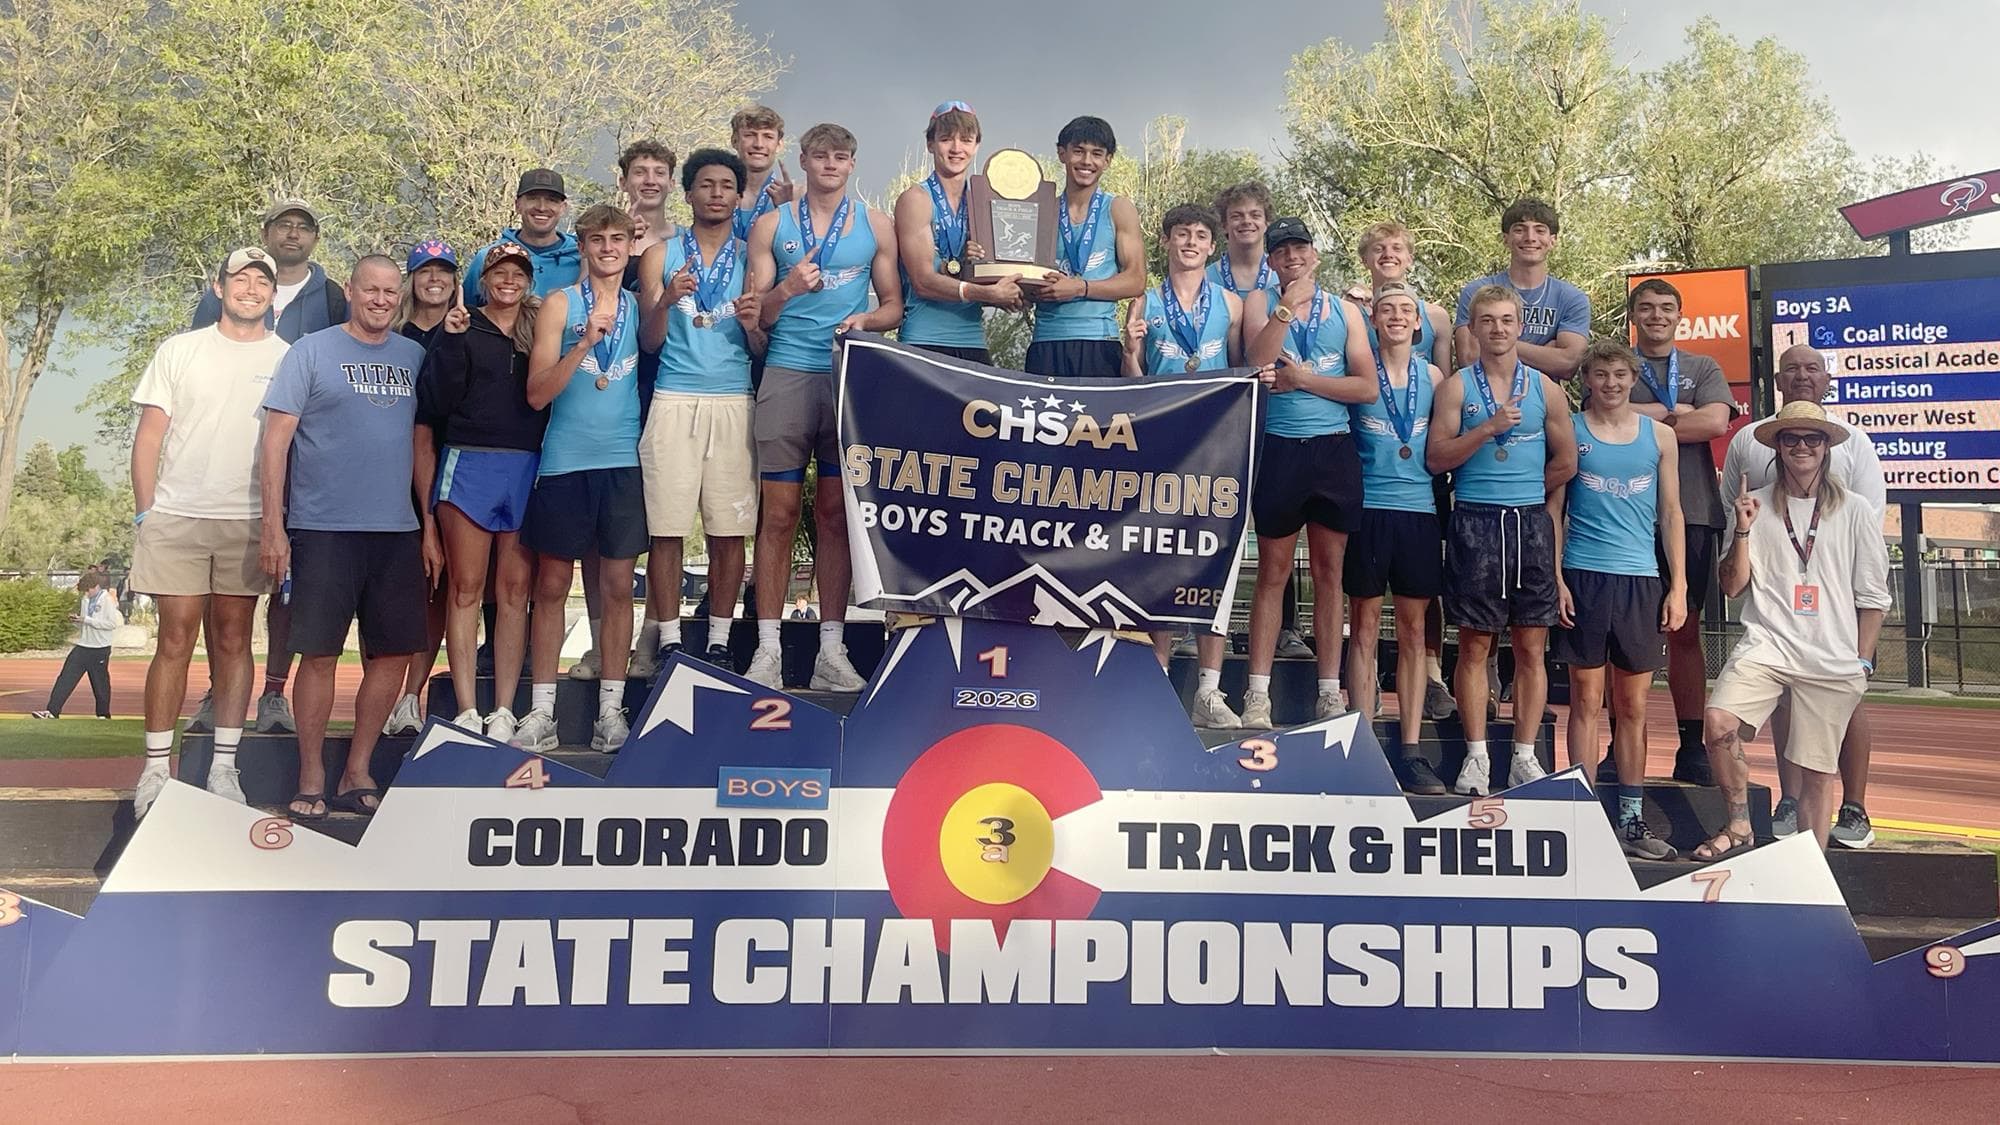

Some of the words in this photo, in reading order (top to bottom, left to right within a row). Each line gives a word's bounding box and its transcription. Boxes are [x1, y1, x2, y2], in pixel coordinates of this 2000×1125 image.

[1521, 306, 1557, 327] TAN
[1776, 299, 1821, 319] Boys
[1826, 296, 1851, 314] 3A
[1675, 314, 1741, 341] BANK
[1786, 329, 1795, 345] 1
[1843, 324, 1886, 343] Coal
[1892, 322, 1948, 343] Ridge
[1844, 353, 1929, 371] Classical
[1936, 349, 2000, 367] Acade
[341, 363, 414, 388] TITAN
[1845, 381, 1933, 399] Harrison
[353, 384, 378, 394] TRACK
[390, 386, 411, 397] FIELD
[961, 400, 1139, 451] CHSAA
[1847, 411, 1918, 427] Denver
[1924, 409, 1976, 425] West
[1873, 437, 1946, 459] asburg
[846, 444, 979, 500] STATE
[992, 461, 1240, 519] CHAMPIONS
[1884, 467, 1979, 484] urrection
[859, 501, 948, 536] BOYS
[960, 512, 1075, 548] TRACK
[1085, 523, 1109, 551] &
[1122, 525, 1219, 557] FIELD
[976, 645, 1009, 678] 1
[956, 690, 1037, 708] 2026
[750, 698, 793, 731] 2
[1238, 738, 1278, 772] 3
[505, 757, 550, 790] 4
[726, 777, 823, 799] BOYS
[1468, 796, 1508, 829] 5
[249, 818, 294, 850] 6
[468, 817, 829, 868] COLORADO
[1118, 822, 1336, 874] TRACK
[1349, 826, 1392, 874] &
[1404, 828, 1567, 877] FIELD
[1691, 870, 1731, 903] 7
[328, 919, 693, 1008] STATE
[712, 918, 1660, 1012] CHAMPIONSHIPS
[1924, 945, 1966, 978] 9
